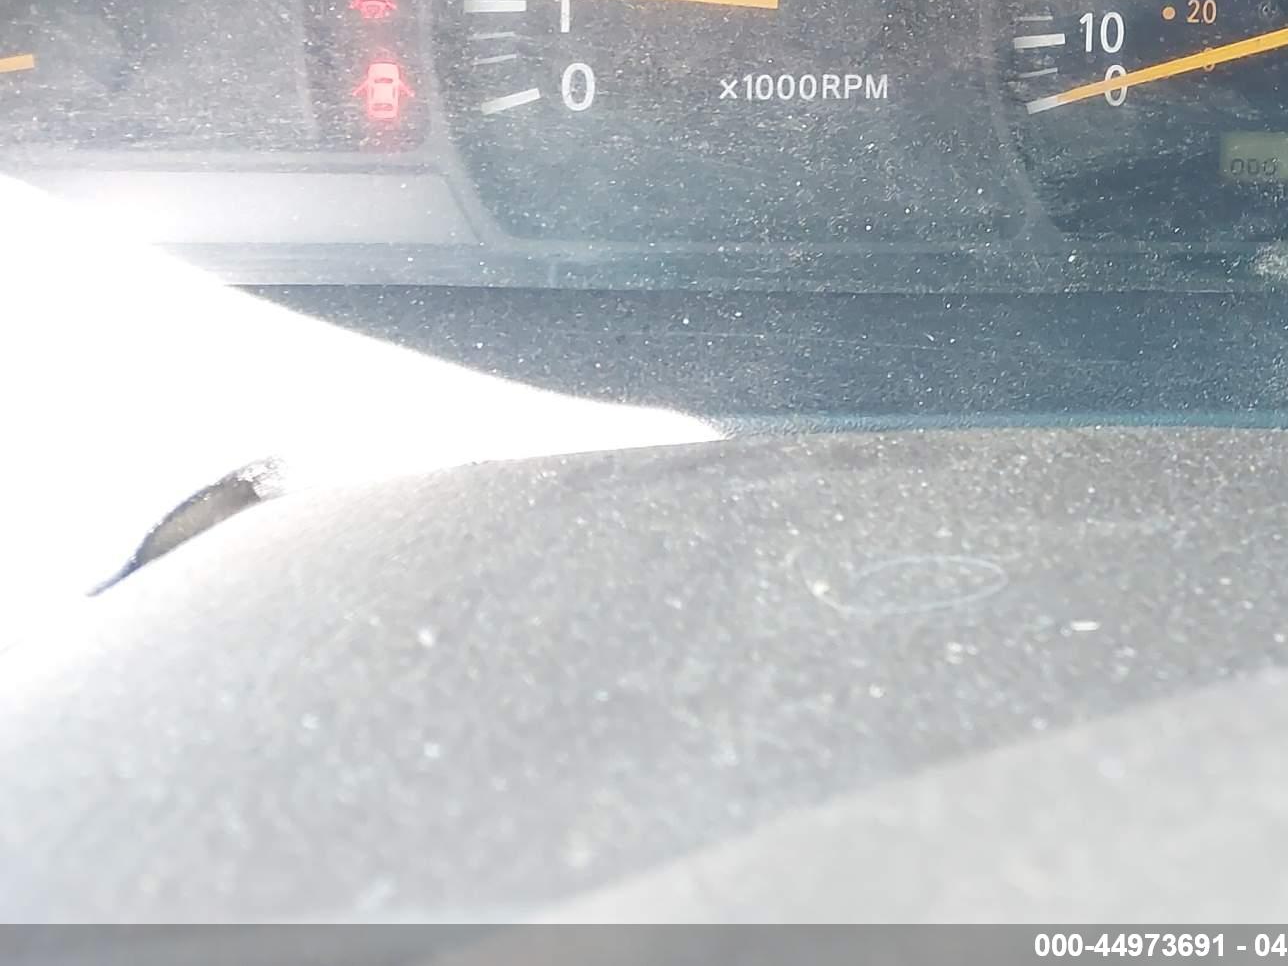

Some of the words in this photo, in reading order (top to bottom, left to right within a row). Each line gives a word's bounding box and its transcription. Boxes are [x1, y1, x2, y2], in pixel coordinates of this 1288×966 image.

[1079, 12, 1125, 54] 10
[1187, 0, 1217, 24] 20
[561, 62, 595, 111] 0
[1104, 64, 1128, 107] 0
